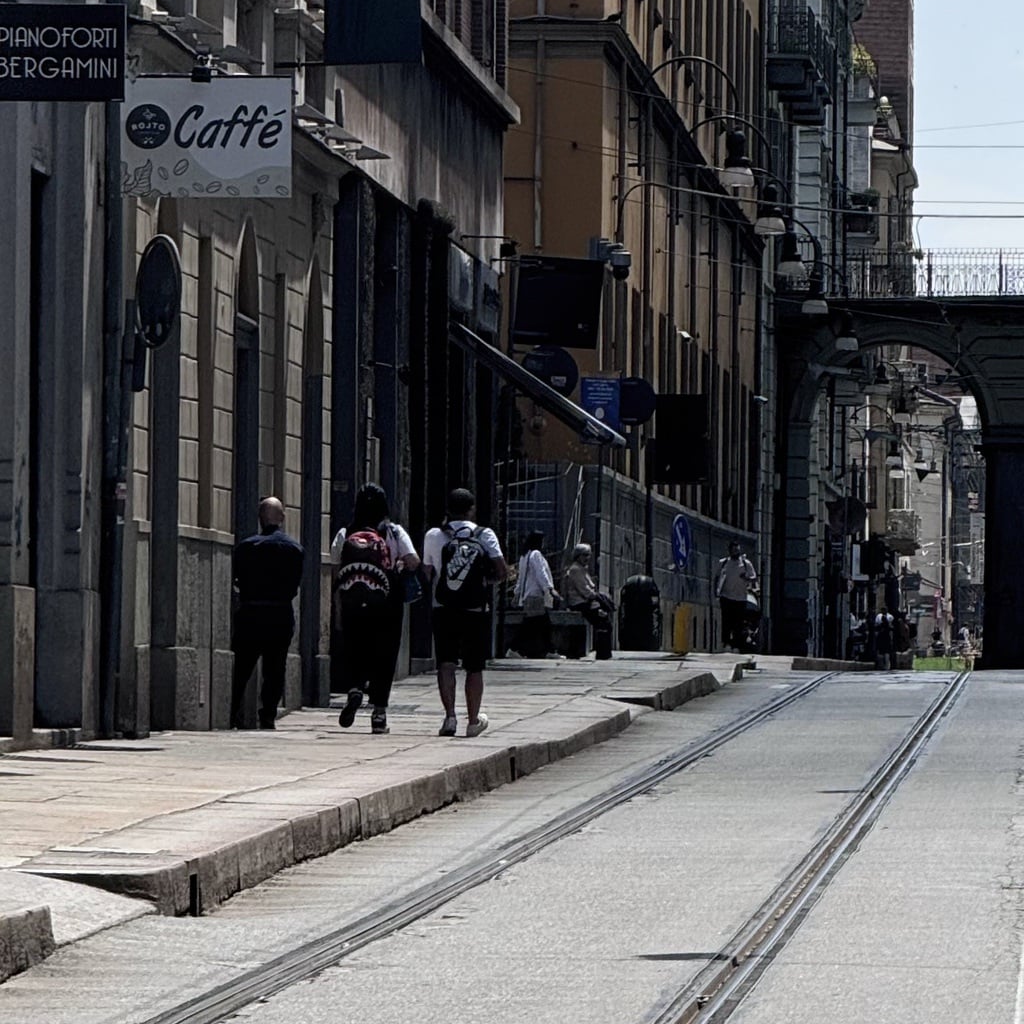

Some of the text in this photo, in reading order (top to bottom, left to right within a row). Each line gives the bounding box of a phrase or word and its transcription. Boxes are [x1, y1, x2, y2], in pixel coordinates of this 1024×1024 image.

[0, 26, 118, 49] PIANOFORTI
[0, 56, 118, 79] BERGAMINI
[174, 104, 287, 149] Caffé
